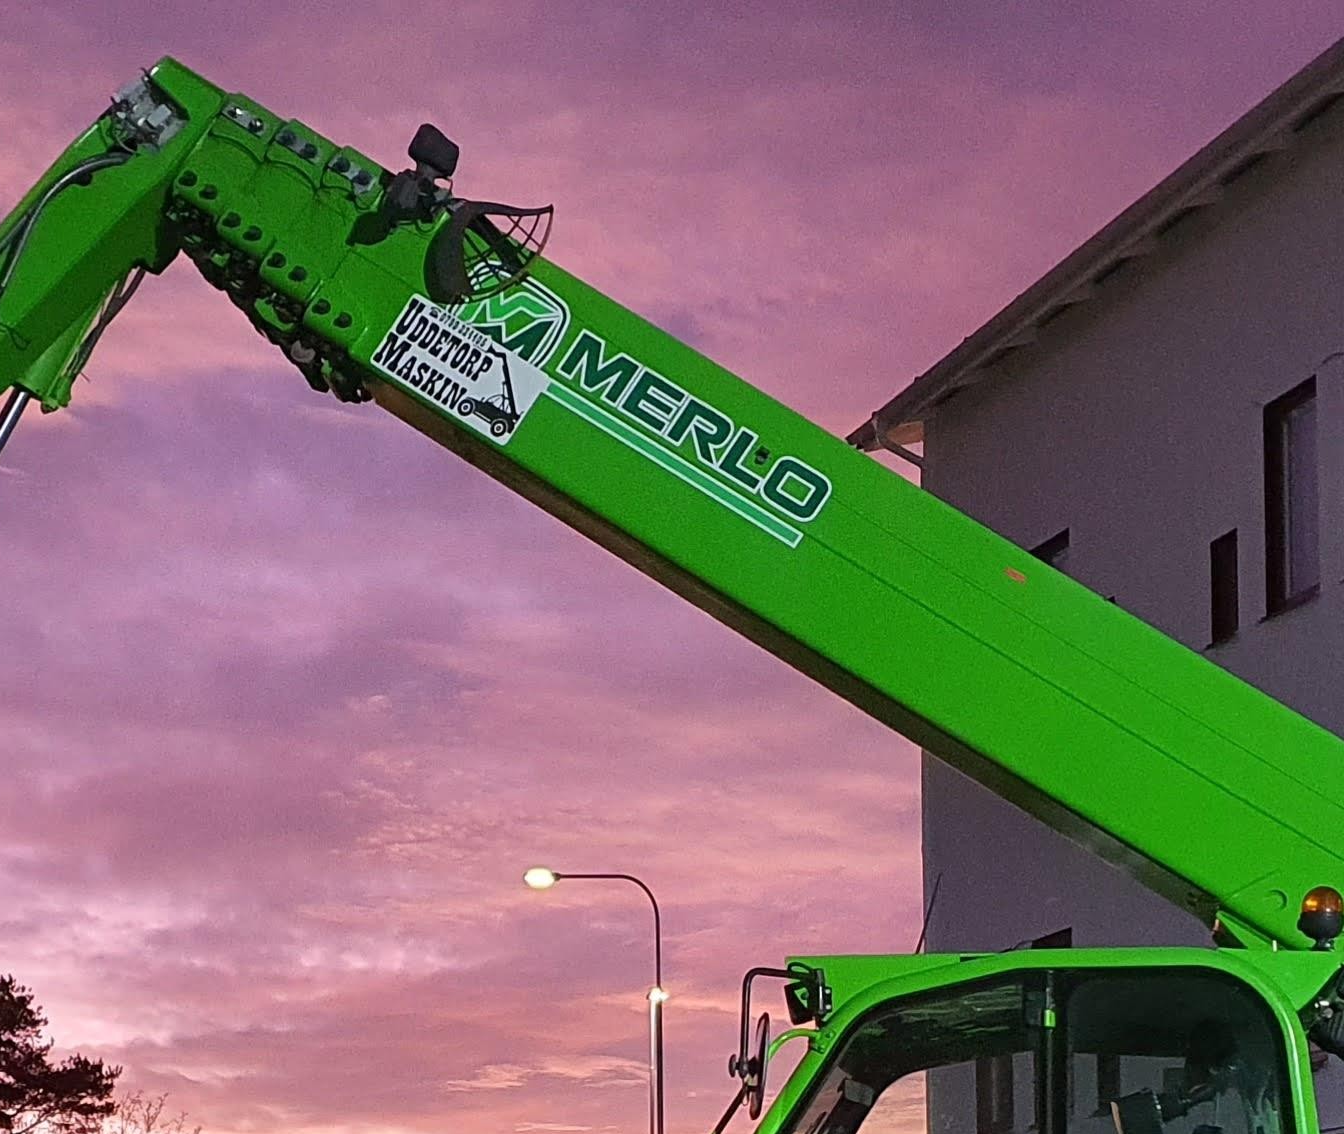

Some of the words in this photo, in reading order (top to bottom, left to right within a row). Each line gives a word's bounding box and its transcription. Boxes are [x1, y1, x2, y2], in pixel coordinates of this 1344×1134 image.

[372, 331, 468, 411] MASKIN
[395, 297, 494, 382] UDDETORP
[556, 328, 833, 523] MERLO
